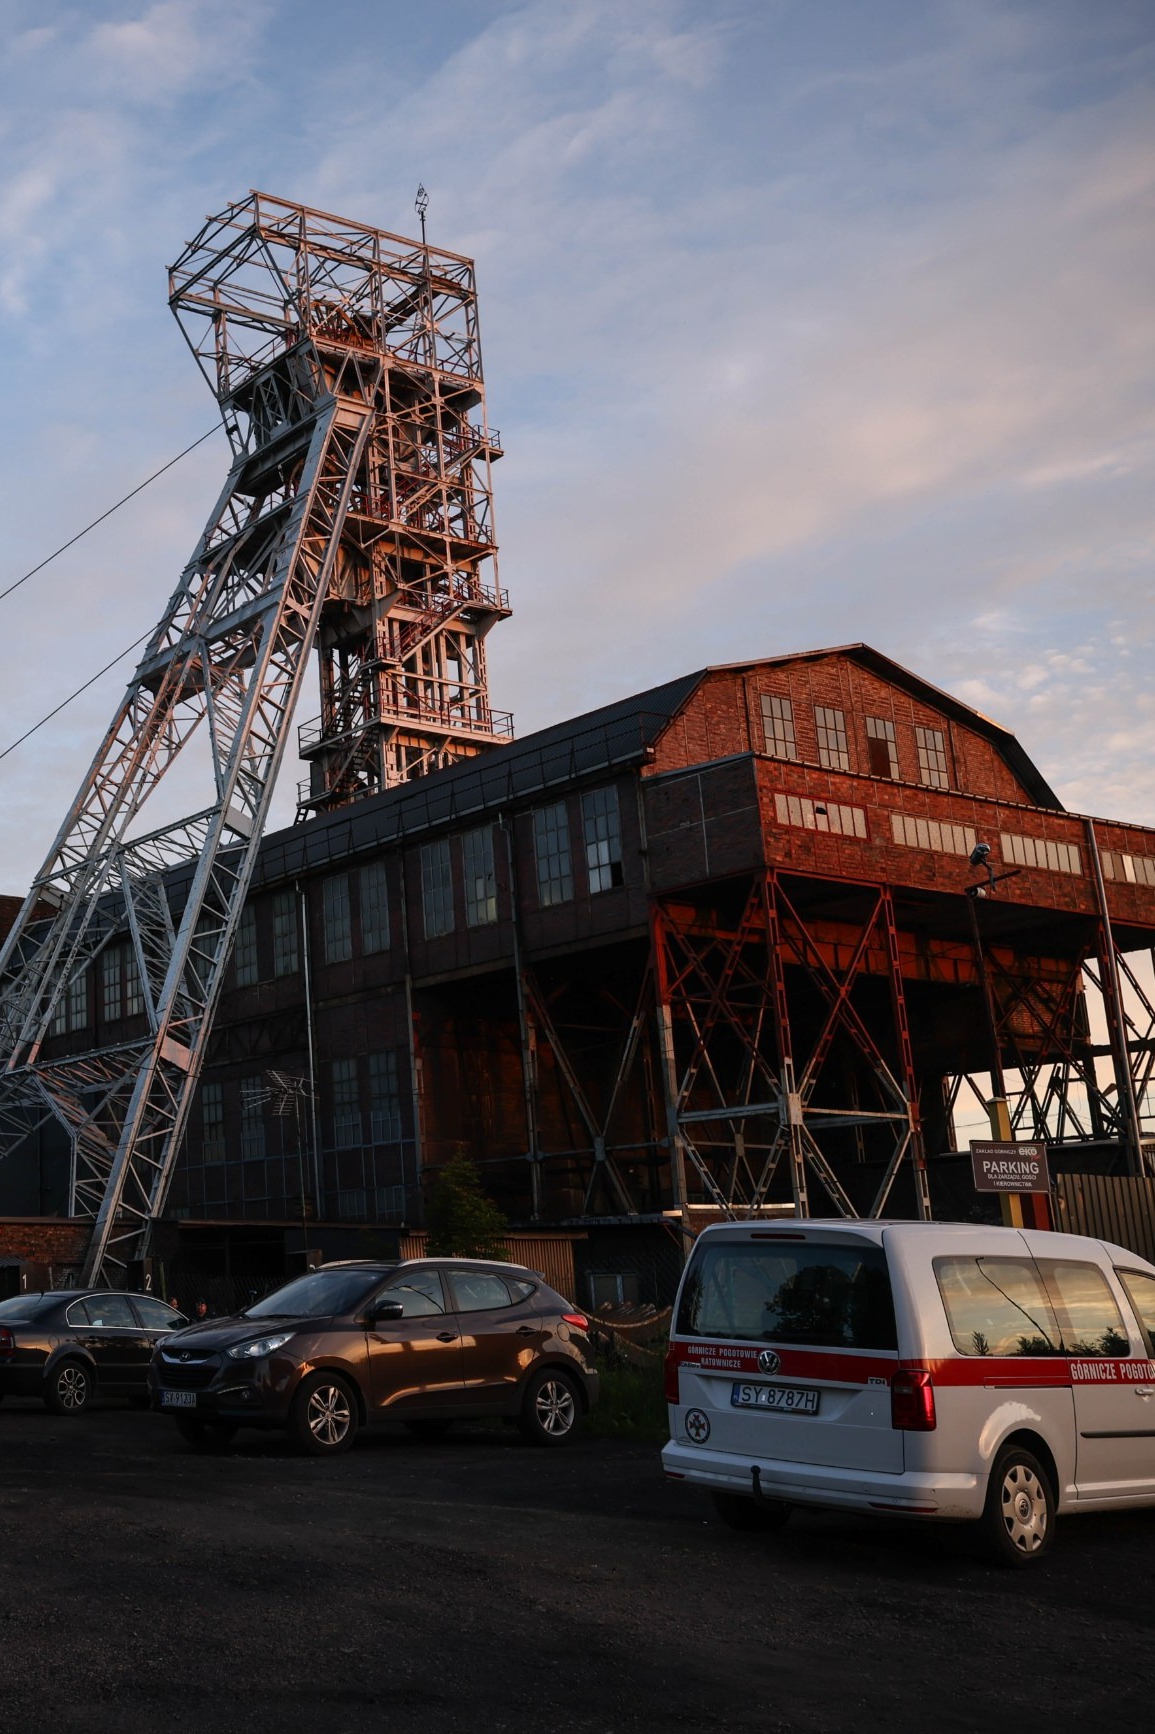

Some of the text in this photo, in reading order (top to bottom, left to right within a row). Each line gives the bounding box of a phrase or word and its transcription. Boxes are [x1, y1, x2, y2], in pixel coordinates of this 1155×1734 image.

[983, 1161, 1039, 1174] PARKING
[22, 1274, 27, 1289] 1
[145, 1274, 152, 1290] 2
[687, 1344, 758, 1359] GÓRNICZE POGOTOWIE
[700, 1358, 741, 1368] RATOWNICZE
[1070, 1360, 1117, 1380] GÓRNICZE
[741, 1386, 763, 1403] SY
[767, 1389, 816, 1409] 8787H
